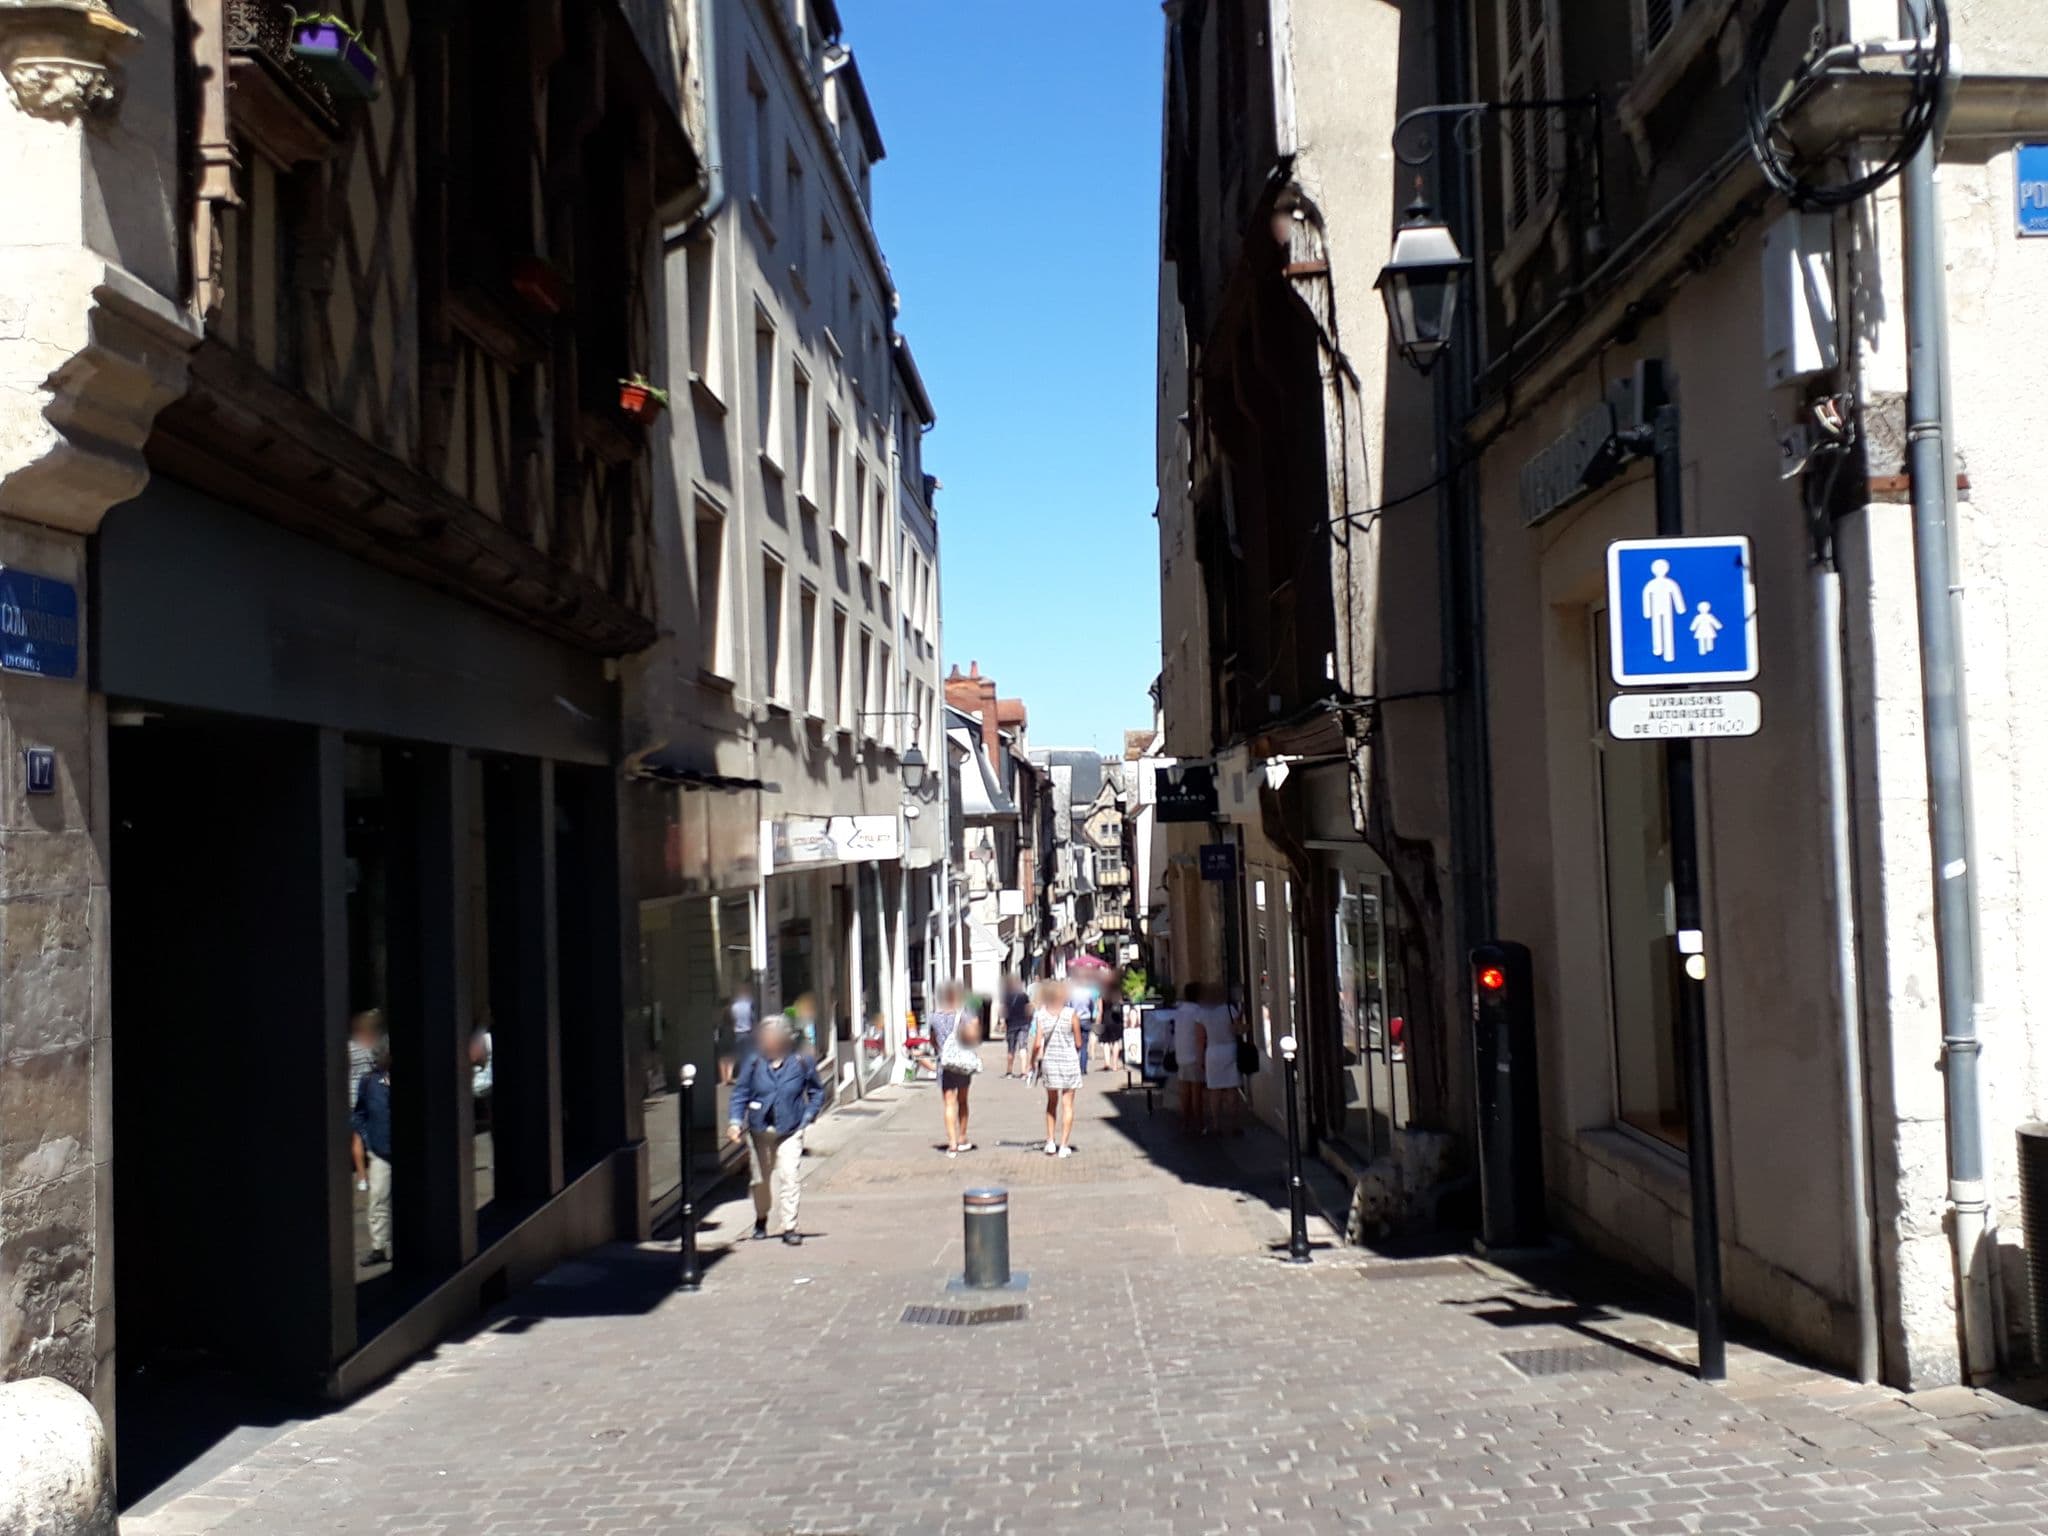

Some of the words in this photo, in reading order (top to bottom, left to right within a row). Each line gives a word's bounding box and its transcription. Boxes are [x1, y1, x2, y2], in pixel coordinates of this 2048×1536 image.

[2020, 181, 2048, 210] PO
[1649, 696, 1723, 707] LIVRAISONS
[1633, 723, 1649, 734] DE
[34, 756, 51, 785] 17
